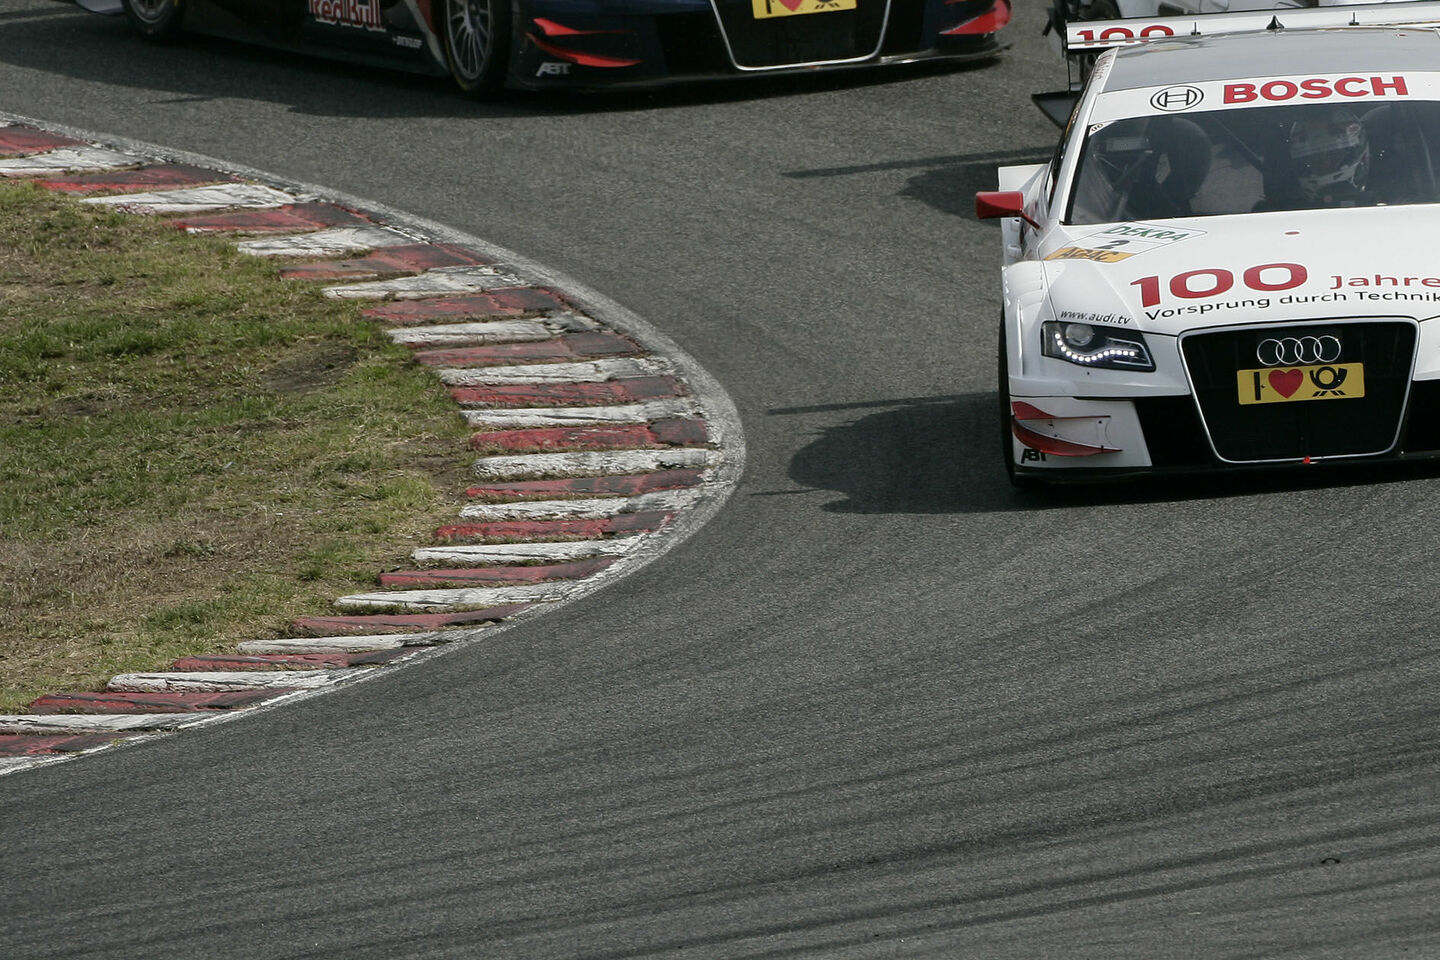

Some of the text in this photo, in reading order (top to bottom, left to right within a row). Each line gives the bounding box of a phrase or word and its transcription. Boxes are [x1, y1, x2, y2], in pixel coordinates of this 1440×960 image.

[1076, 24, 1175, 46] 100
[535, 61, 571, 77] ABT
[1222, 76, 1410, 105] BOSCH
[1103, 225, 1191, 241] DEKRA
[1093, 239, 1131, 250] 2
[1130, 262, 1308, 309] 100
[1144, 295, 1271, 321] Vorsprung
[1279, 290, 1348, 305] durch
[1060, 309, 1132, 325] www.audi.tv
